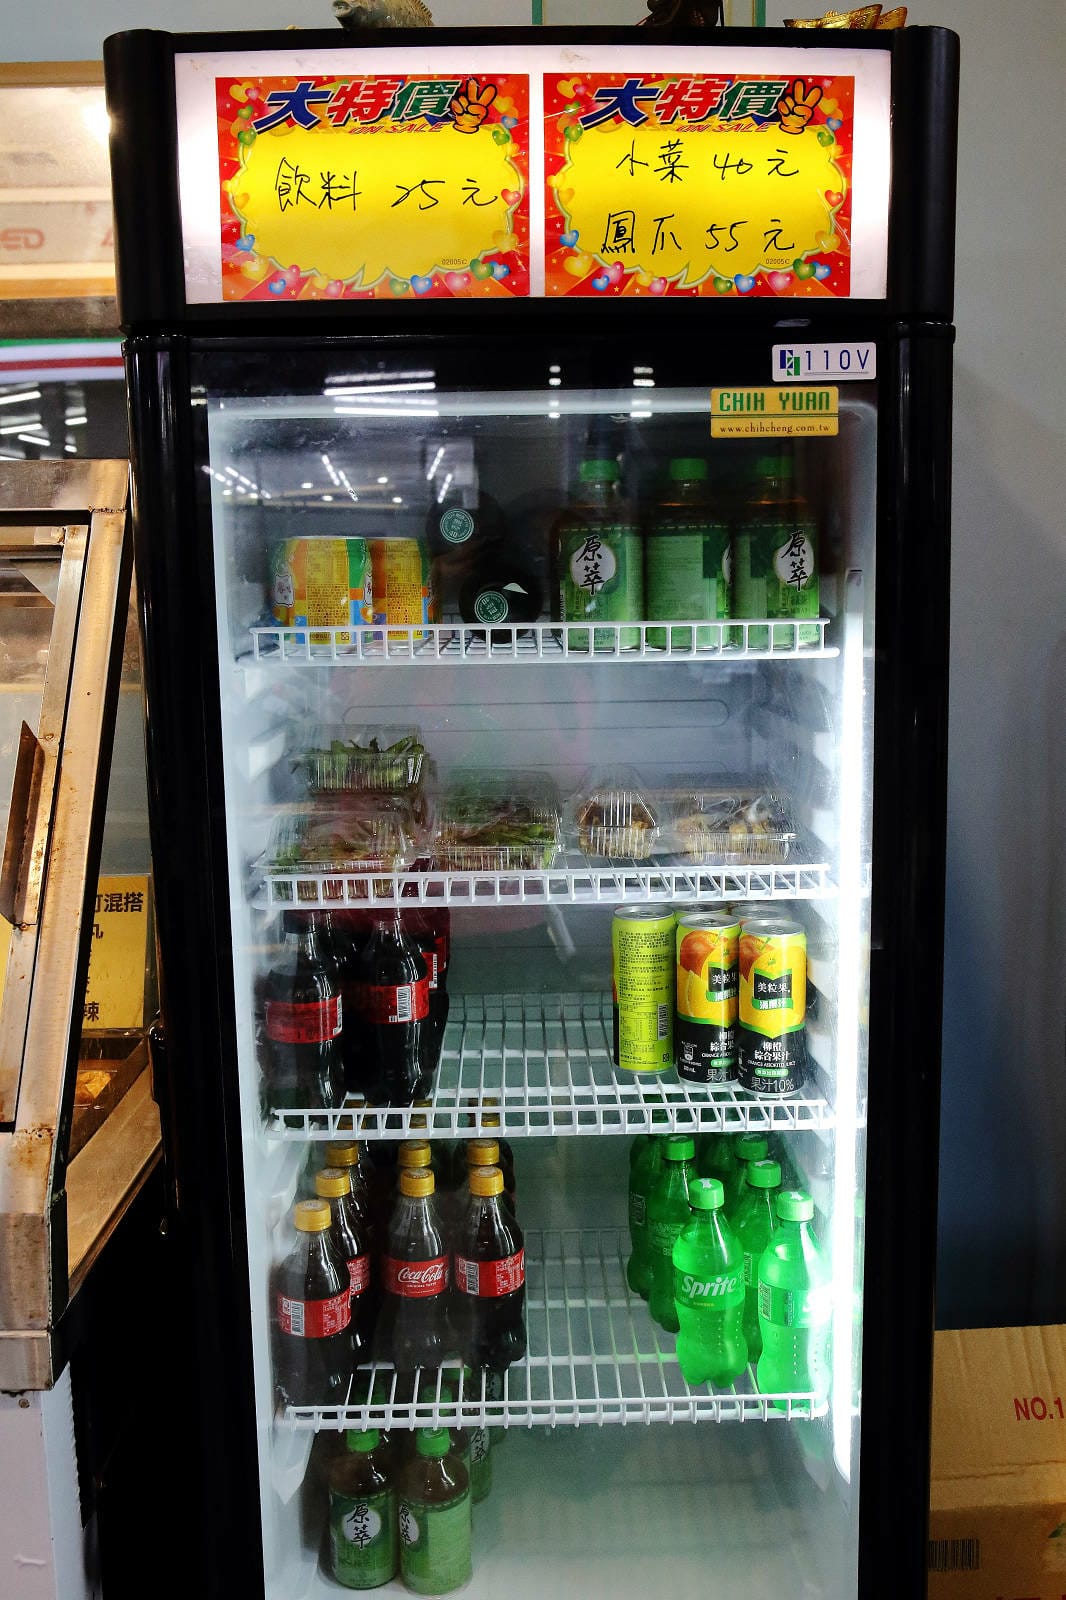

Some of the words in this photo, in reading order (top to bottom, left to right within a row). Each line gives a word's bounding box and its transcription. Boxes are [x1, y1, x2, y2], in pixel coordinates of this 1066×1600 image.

[253, 79, 462, 134] 大特價
[579, 78, 789, 129] 大特價
[349, 125, 382, 134] ON
[385, 122, 445, 133] SALE
[676, 123, 710, 133] ON
[713, 121, 778, 133] SALE
[616, 139, 690, 183] 小菜
[713, 153, 753, 180] 40
[767, 149, 799, 176] 元
[275, 157, 362, 211] 飲料
[462, 179, 498, 207] 元
[600, 210, 682, 255] 鳳爪
[705, 221, 748, 251] 55
[764, 219, 795, 251] 元
[805, 349, 870, 371] 110V
[719, 392, 765, 411] CHIH
[778, 391, 830, 411] YUAN
[719, 421, 831, 434] www.chihcheng.com.tw
[576, 535, 605, 595] 原萃
[780, 530, 809, 592] 原萃
[681, 1275, 737, 1299] Sprite
[346, 1503, 371, 1550] 原萃
